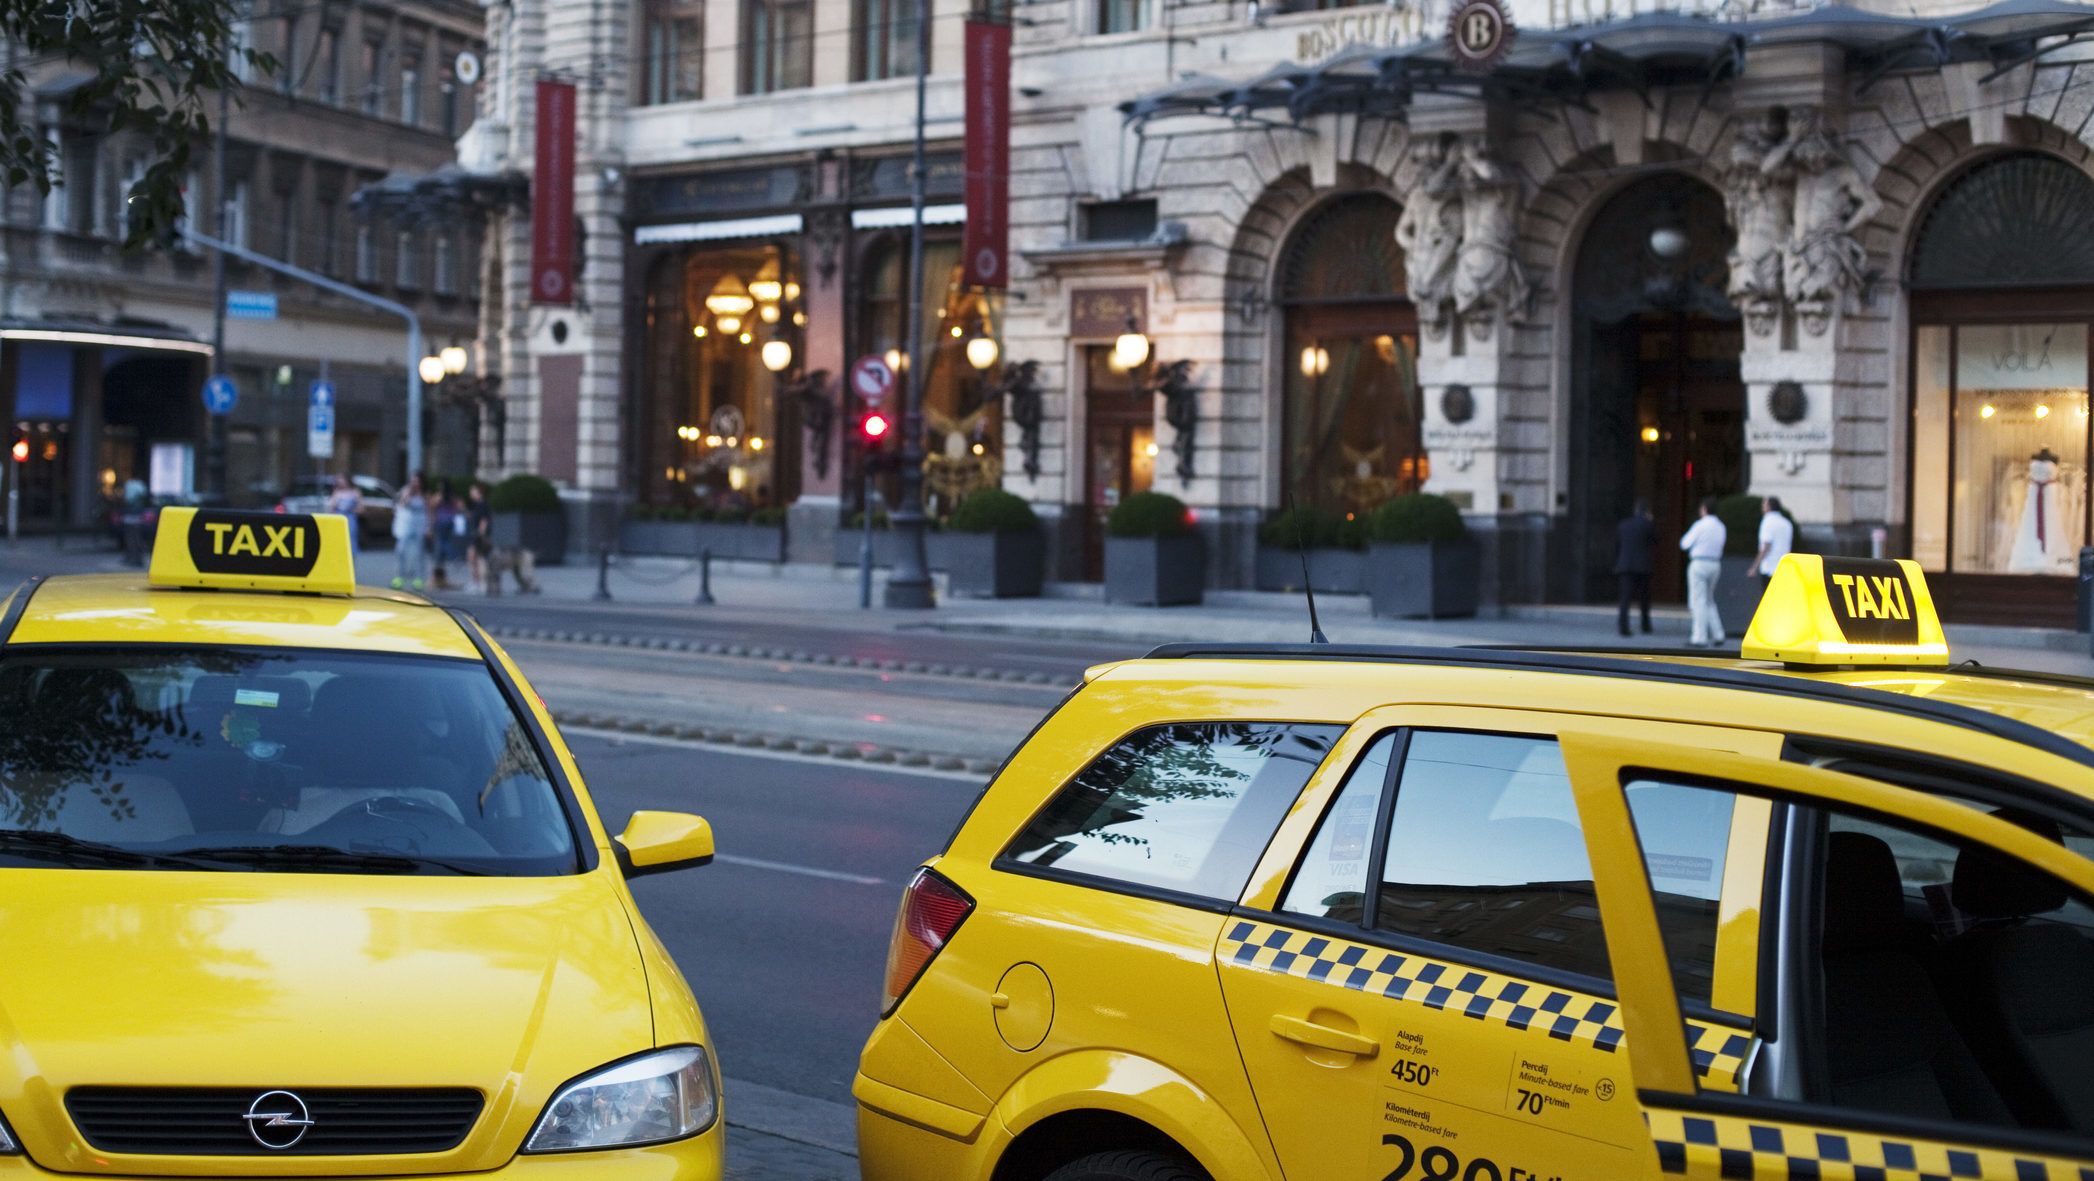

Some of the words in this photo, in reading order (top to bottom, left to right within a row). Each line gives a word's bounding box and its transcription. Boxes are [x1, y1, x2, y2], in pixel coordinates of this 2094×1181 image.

[1466, 14, 1491, 48] B
[205, 523, 304, 558] TAXI
[1832, 574, 1910, 619] TAXI
[1329, 863, 1358, 876] VISA
[1394, 1041, 1412, 1052] Base
[1412, 1045, 1428, 1056] fare
[1519, 1071, 1573, 1092] Minute-based
[1572, 1084, 1590, 1096] fare
[1384, 1112, 1442, 1135] Kilometre-based
[1442, 1127, 1458, 1139] fare
